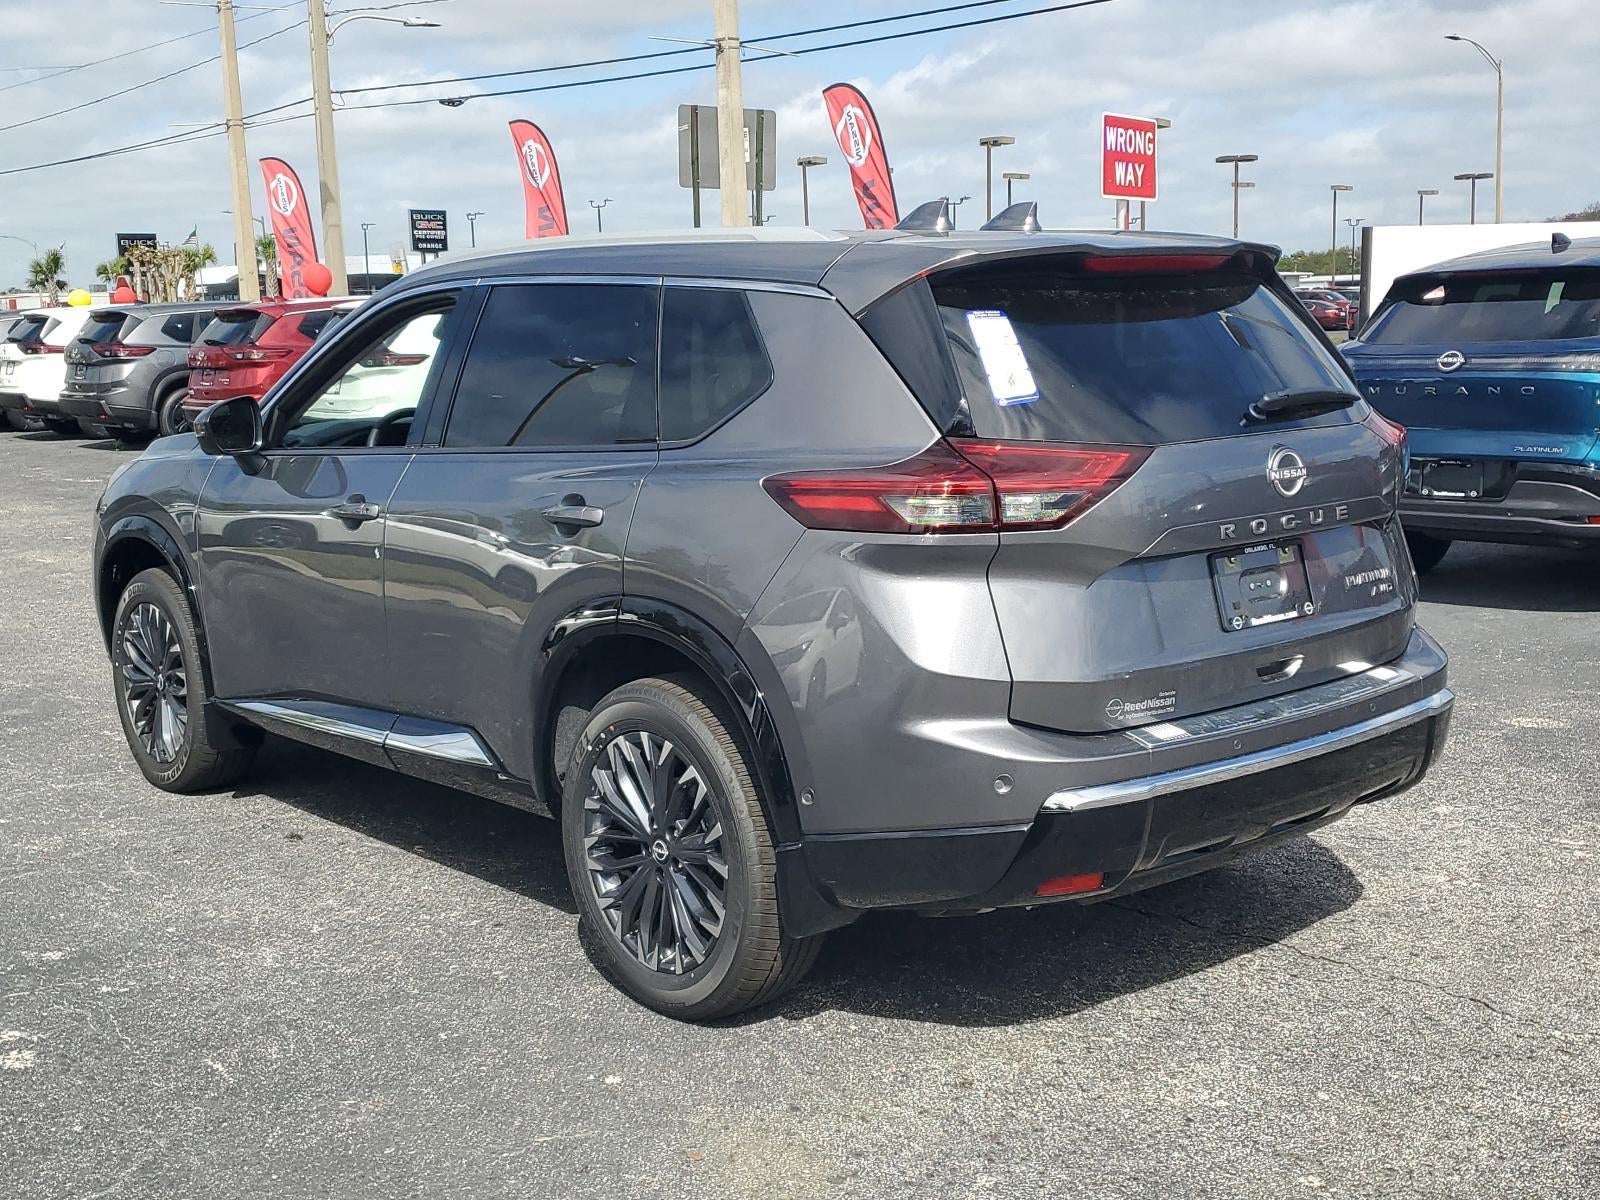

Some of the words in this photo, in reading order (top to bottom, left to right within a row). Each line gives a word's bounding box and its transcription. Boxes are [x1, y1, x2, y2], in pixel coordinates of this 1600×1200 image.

[1105, 126, 1154, 156] WRONG
[1115, 161, 1145, 187] WAY
[416, 221, 444, 229] GMC
[1368, 386, 1535, 396] MURANO
[1514, 446, 1563, 454] PLATINUM
[1271, 467, 1307, 481] NISSAN
[1220, 506, 1349, 540] ROGUE
[1147, 697, 1176, 709] Nissan
